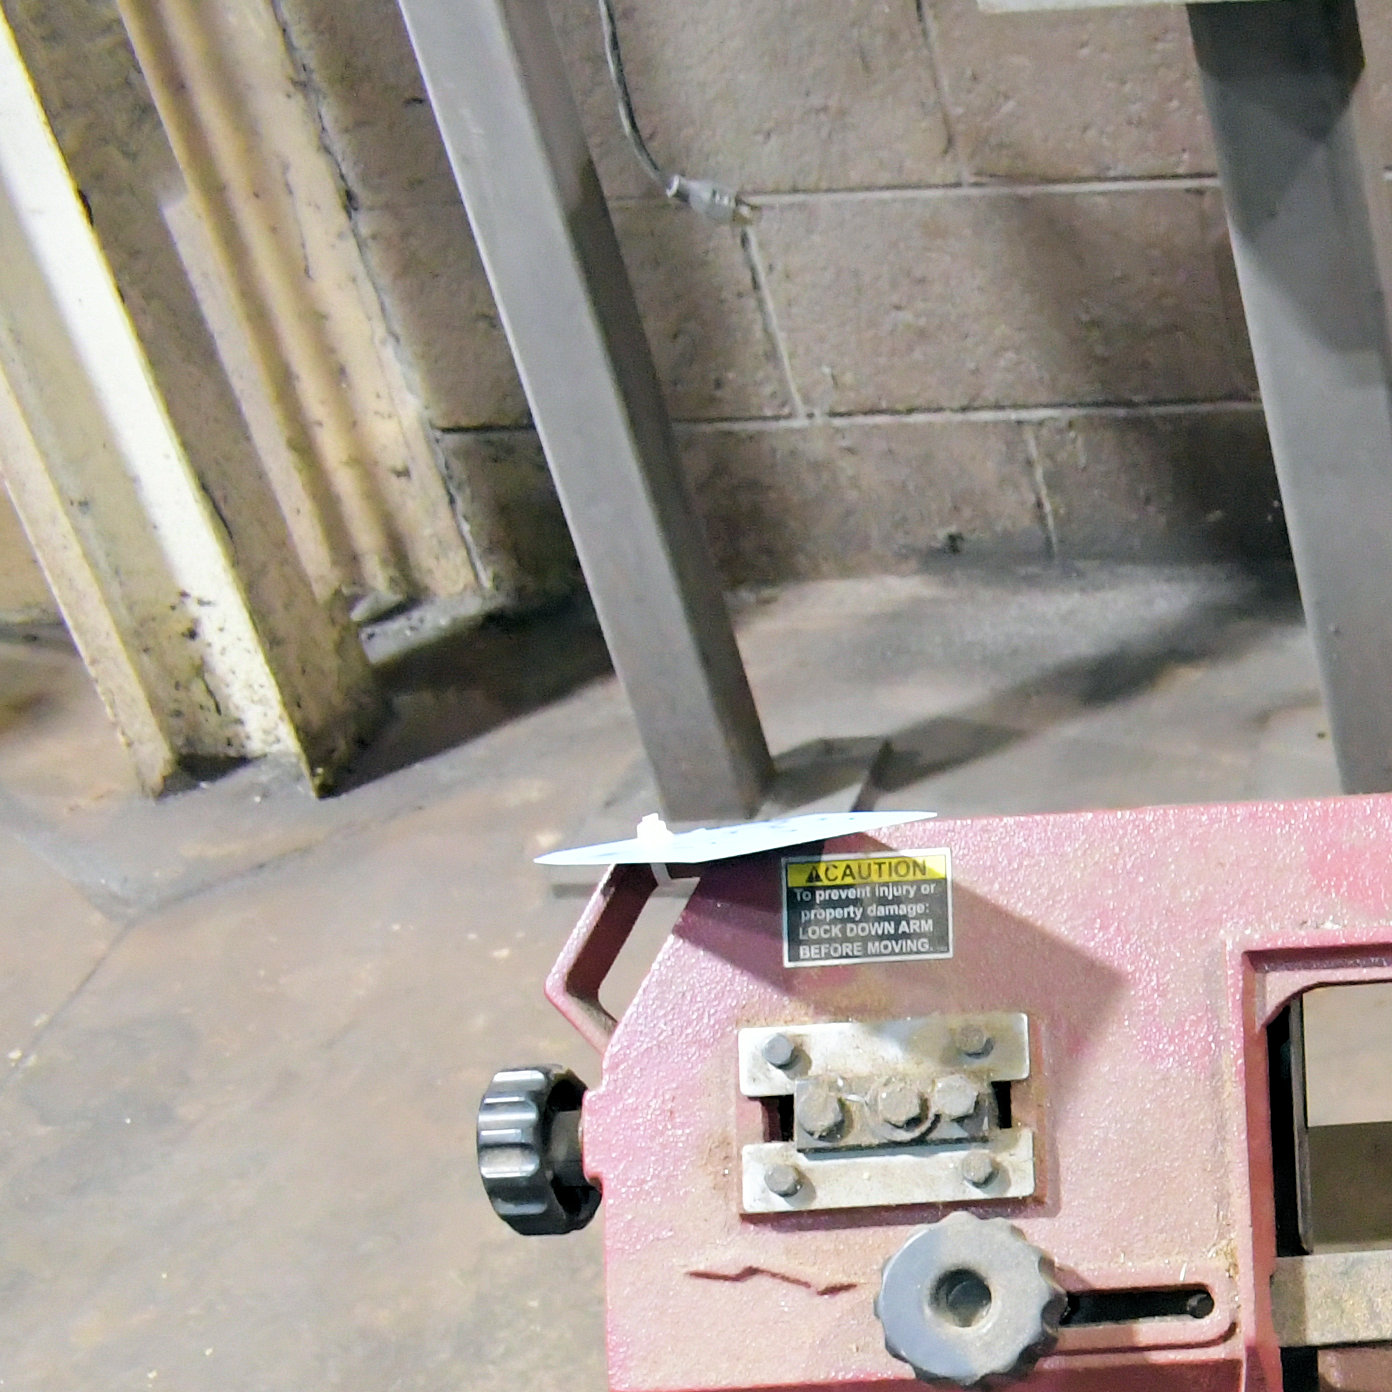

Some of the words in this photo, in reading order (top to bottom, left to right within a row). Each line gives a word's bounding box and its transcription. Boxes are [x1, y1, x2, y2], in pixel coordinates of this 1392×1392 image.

[825, 861, 927, 882] CAUTION
[794, 888, 812, 902] To
[815, 887, 870, 904] prevent
[921, 883, 937, 895] or
[801, 904, 863, 924] property
[867, 902, 930, 919] damage:
[799, 923, 842, 940] LOCK
[846, 920, 895, 937] DOWN
[899, 918, 933, 934] ARM
[799, 942, 863, 960] BEFORE
[867, 938, 933, 956] MOVING.
